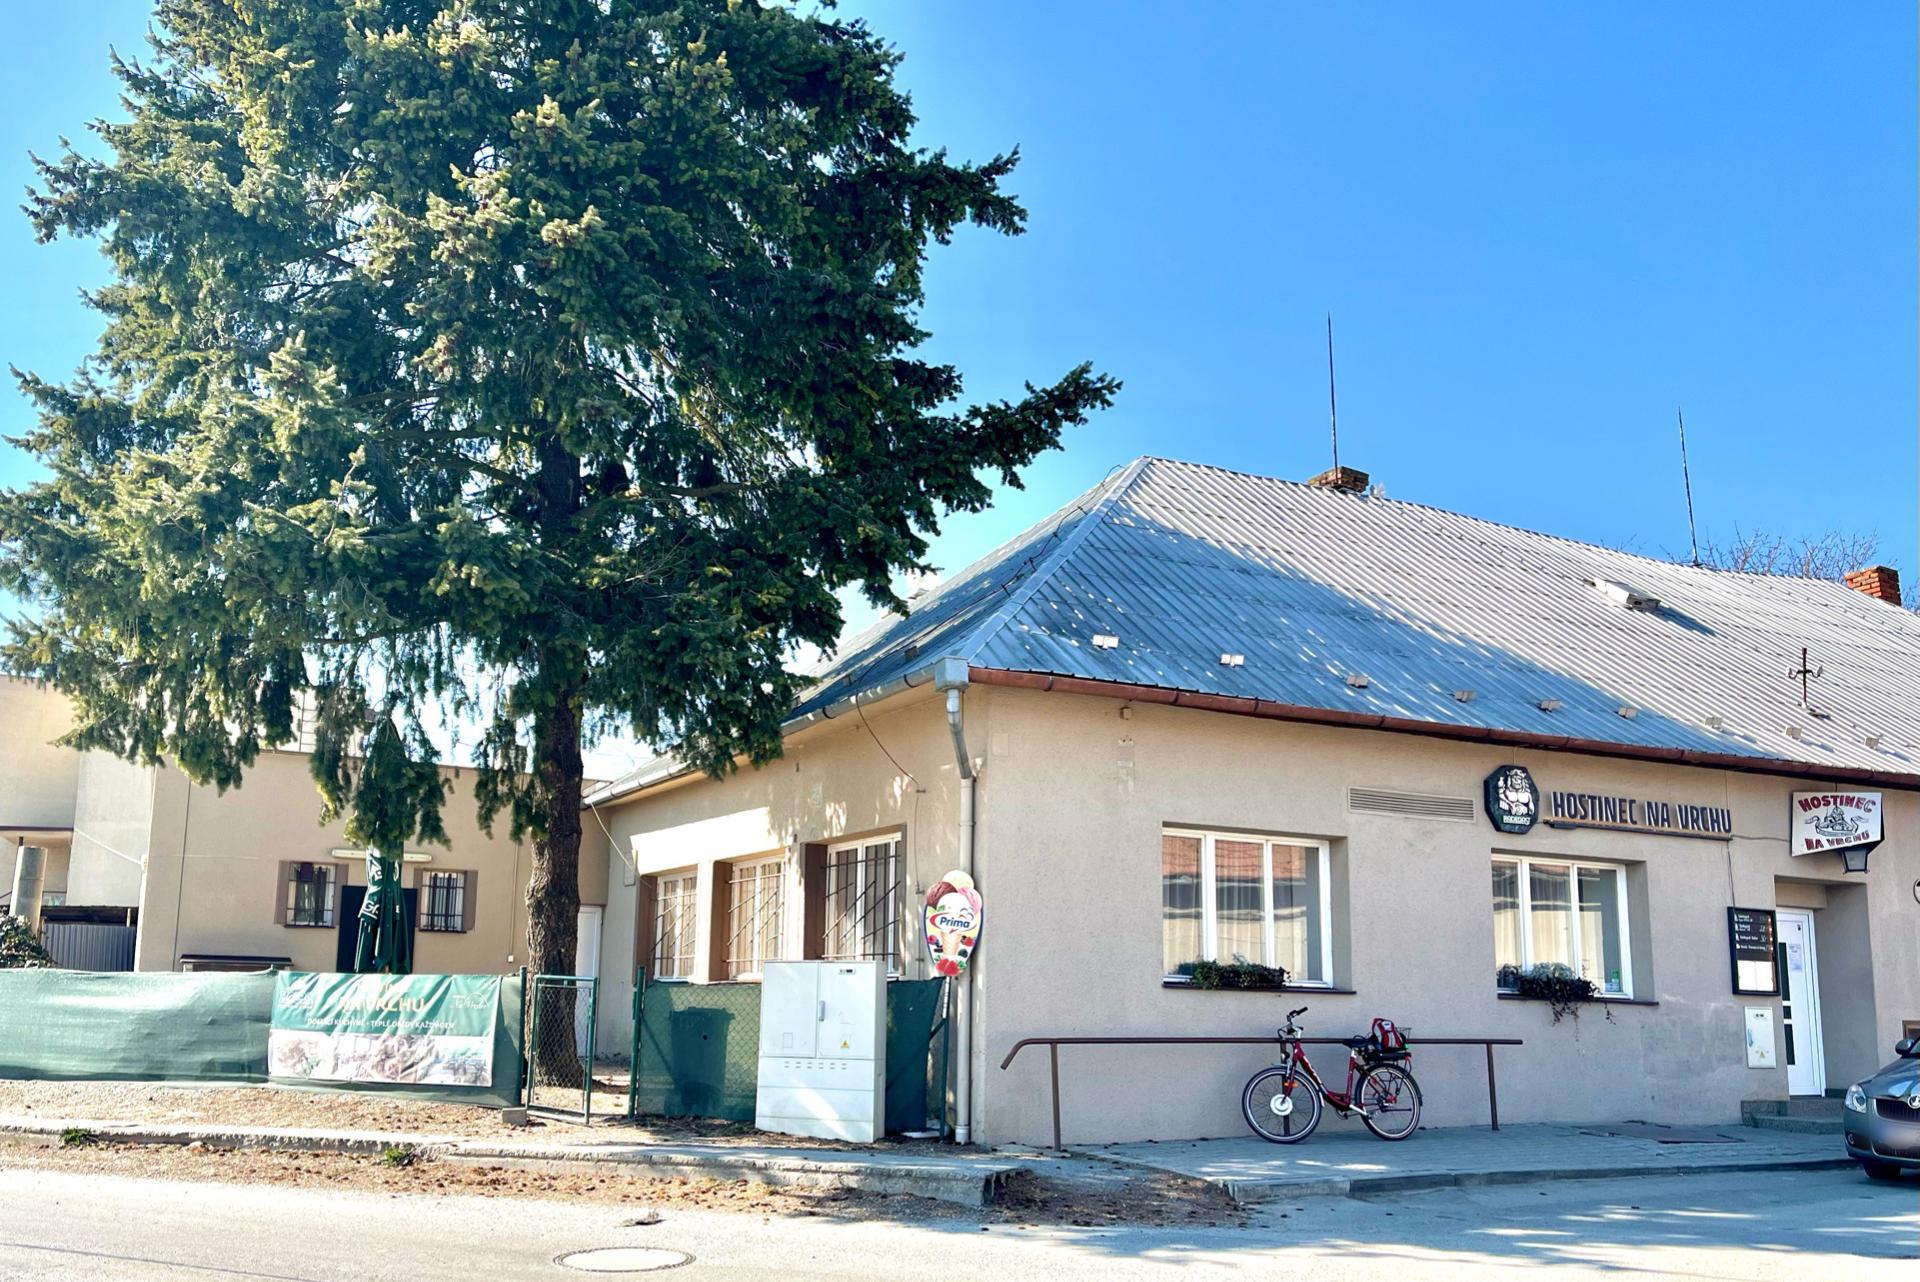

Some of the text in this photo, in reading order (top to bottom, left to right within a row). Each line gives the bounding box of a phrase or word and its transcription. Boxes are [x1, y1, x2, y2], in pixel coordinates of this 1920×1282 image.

[1551, 791, 1732, 833] HOSTINEC NA VRCHU
[1798, 795, 1877, 814] HOSTINEC
[1805, 830, 1870, 851] NA VRCHU
[939, 916, 970, 929] Prima
